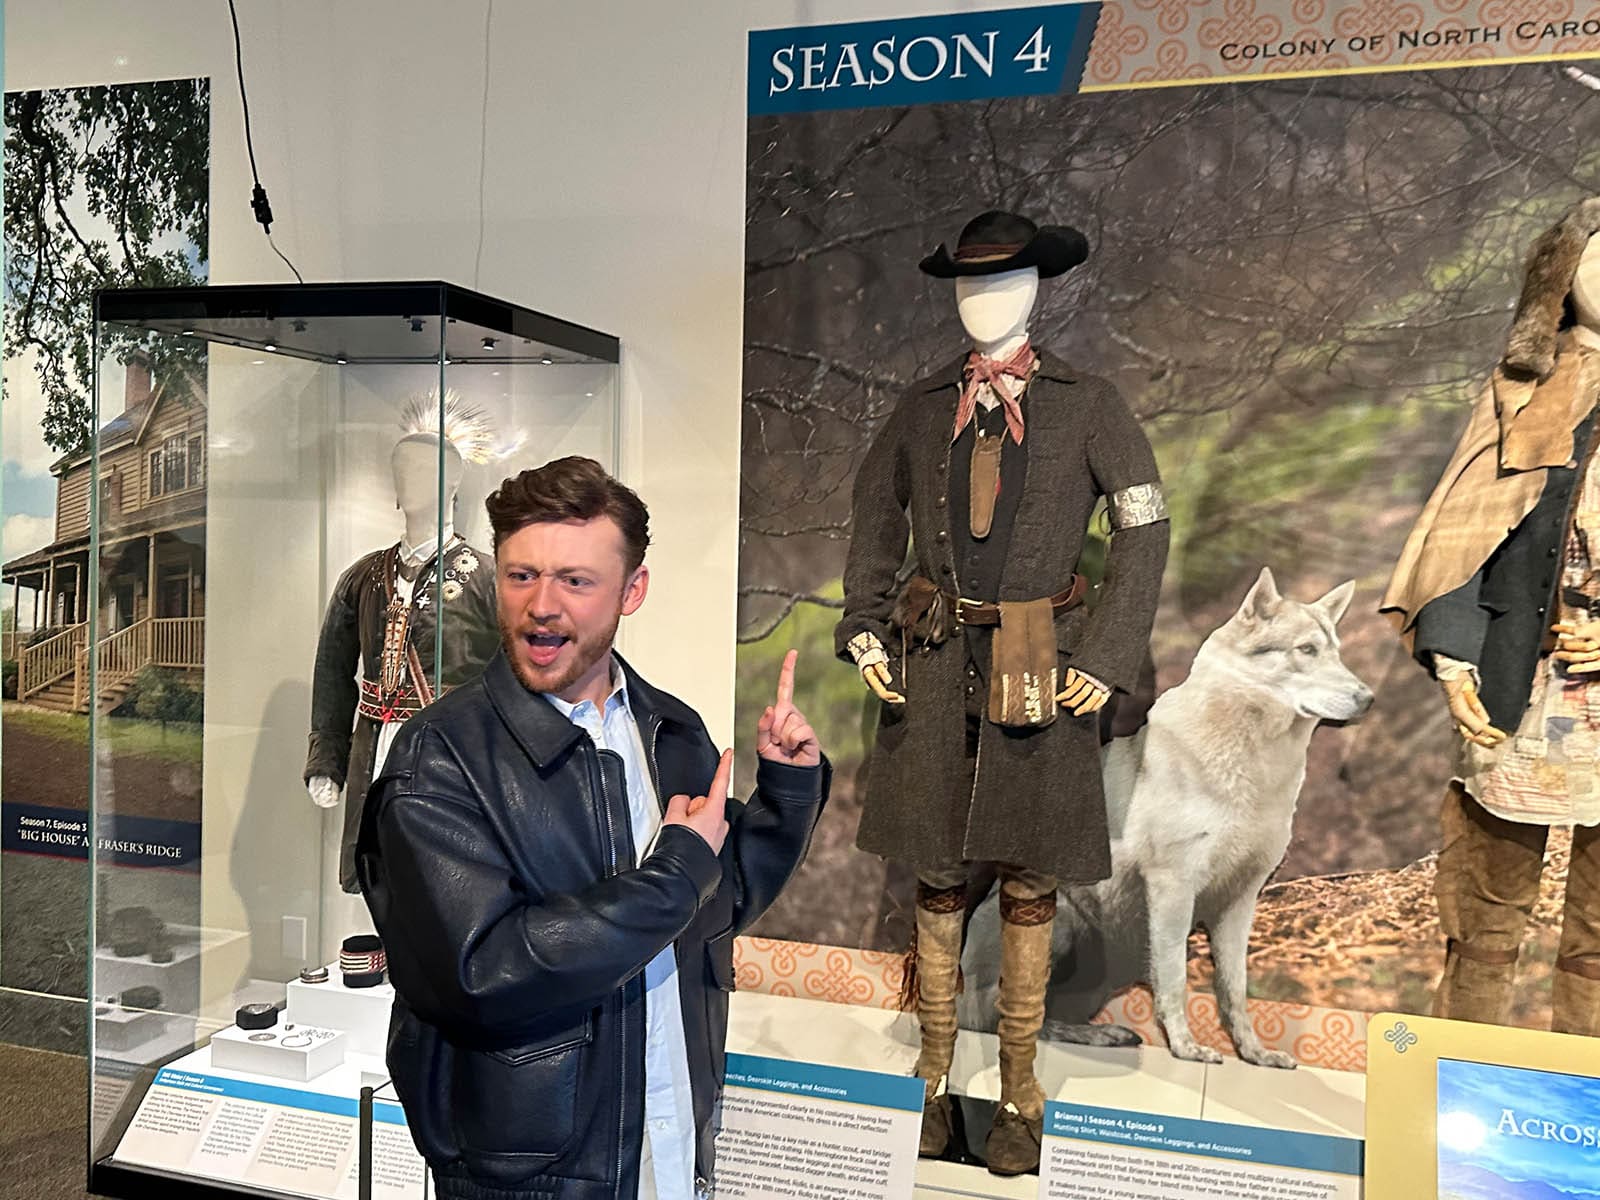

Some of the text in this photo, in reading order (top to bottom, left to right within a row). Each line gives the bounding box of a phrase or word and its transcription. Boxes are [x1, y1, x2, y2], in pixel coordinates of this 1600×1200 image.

[1219, 37, 1336, 61] COLONY
[1349, 34, 1384, 51] OF
[1399, 27, 1501, 49] NORTH
[769, 25, 1051, 97] SEASON 4
[20, 816, 86, 832] Season 7, Episode 3
[82, 836, 90, 847] A
[98, 838, 144, 854] FRASER'S
[146, 844, 182, 858] RIDGE
[725, 1072, 847, 1095] eeches, Deerskin Leggings, and Accessories
[1054, 1111, 1083, 1121] Brianna
[1088, 1116, 1115, 1125] Season
[1116, 1119, 1124, 1128] 4,
[1126, 1121, 1156, 1132] Episode
[1158, 1125, 1164, 1133] 9
[1497, 1108, 1600, 1148] ACROS
[1053, 1123, 1079, 1133] Hunting
[1080, 1127, 1097, 1136] Shirt,
[1099, 1129, 1132, 1140] Waistcoat,
[1134, 1134, 1162, 1142] Deerskin
[1164, 1138, 1195, 1148] Leggings,
[1212, 1145, 1252, 1154] Accessories
